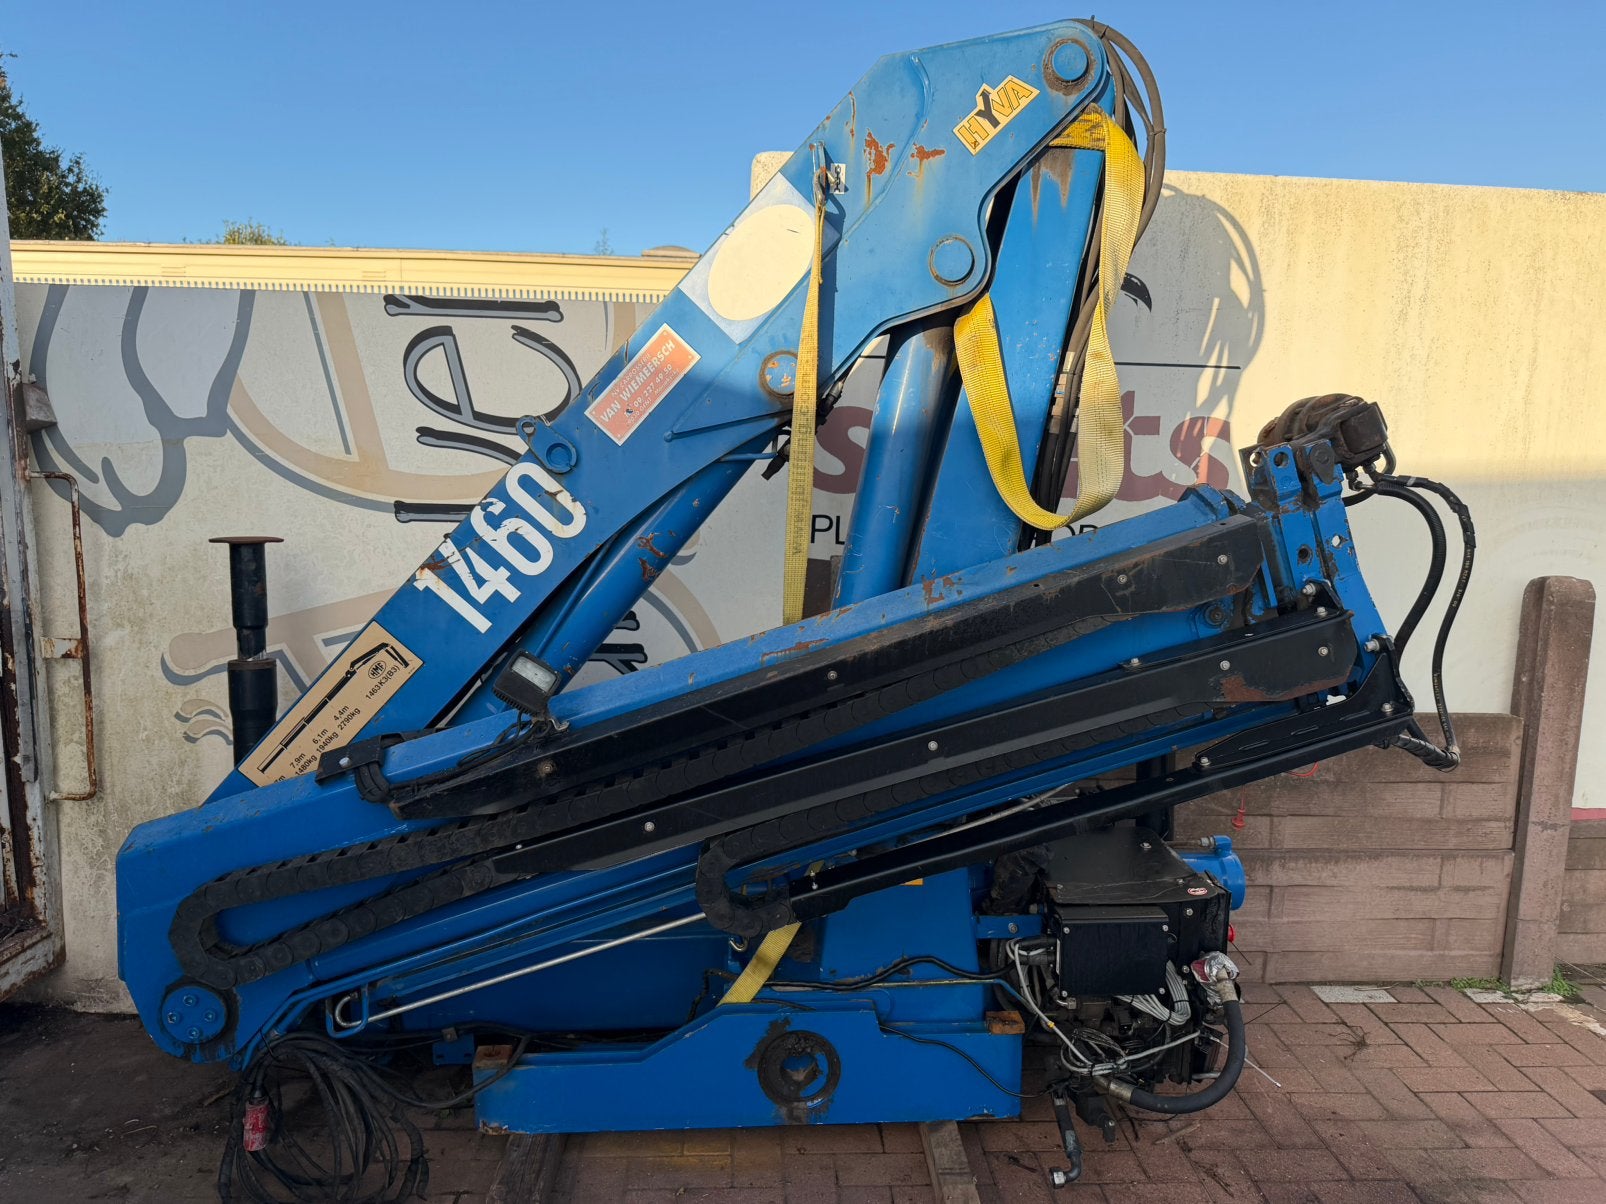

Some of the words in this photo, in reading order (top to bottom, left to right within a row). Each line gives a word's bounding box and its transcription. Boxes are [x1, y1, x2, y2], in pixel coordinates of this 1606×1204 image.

[957, 79, 1034, 150] HYVA
[600, 401, 622, 423] VAN
[620, 340, 676, 402] WIEMEERSCH
[413, 461, 587, 634] 1460
[370, 662, 385, 678] HMF
[290, 752, 306, 769] 7,9m
[312, 728, 328, 745] 6,1m
[333, 705, 350, 721] 4,4m
[295, 755, 318, 776] 1480kg
[316, 731, 339, 753] 1940kg
[337, 707, 361, 731] 2790kg
